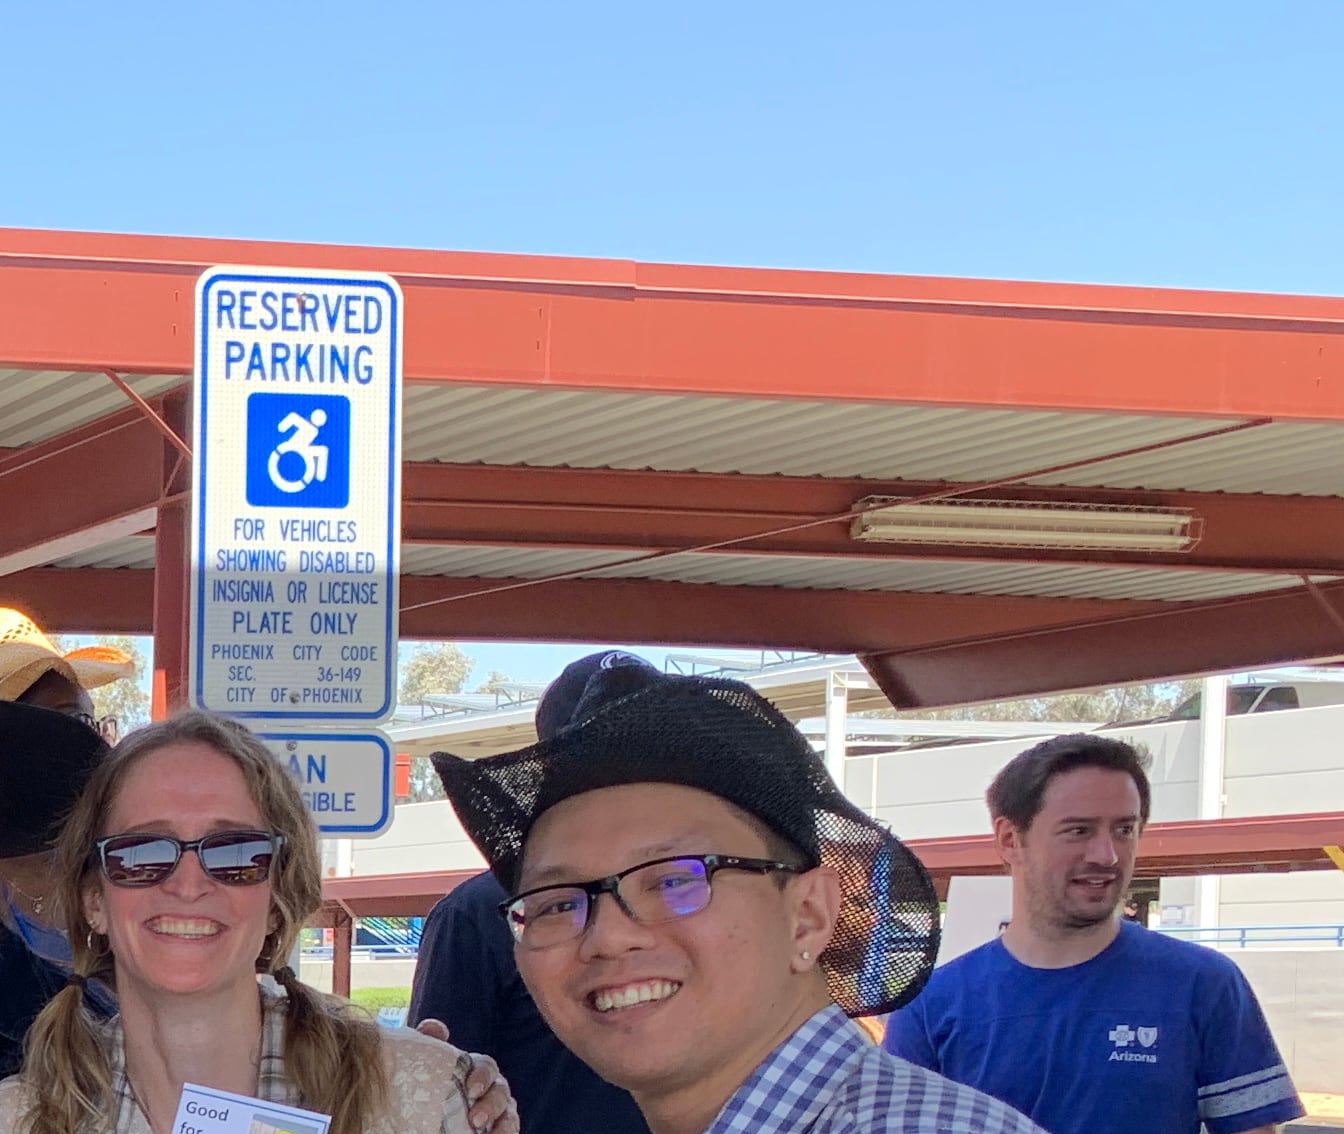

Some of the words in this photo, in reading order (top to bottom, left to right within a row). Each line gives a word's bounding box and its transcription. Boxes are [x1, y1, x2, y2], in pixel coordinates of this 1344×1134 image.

[217, 289, 382, 334] RESERVED
[226, 341, 372, 384] PARKING
[234, 518, 265, 540] FOR
[280, 519, 355, 542] VEHICLES
[216, 550, 287, 573] SHOWING
[301, 552, 374, 574] DISABLED
[212, 580, 274, 603] INSIGNIA
[287, 581, 307, 603] OR
[319, 582, 378, 604] LICENSE
[232, 610, 292, 634] PLATE
[310, 612, 356, 635] ONLY
[212, 643, 274, 660] PHOENIX
[292, 643, 322, 661] CITY
[341, 646, 377, 662] CODE
[317, 667, 361, 683] 36-149
[227, 687, 255, 701] CITY
[272, 688, 287, 702] OF
[303, 688, 360, 702] PHOENIX
[278, 753, 326, 784] AN
[1108, 1051, 1157, 1063] Arizona
[185, 1101, 229, 1122] Good
